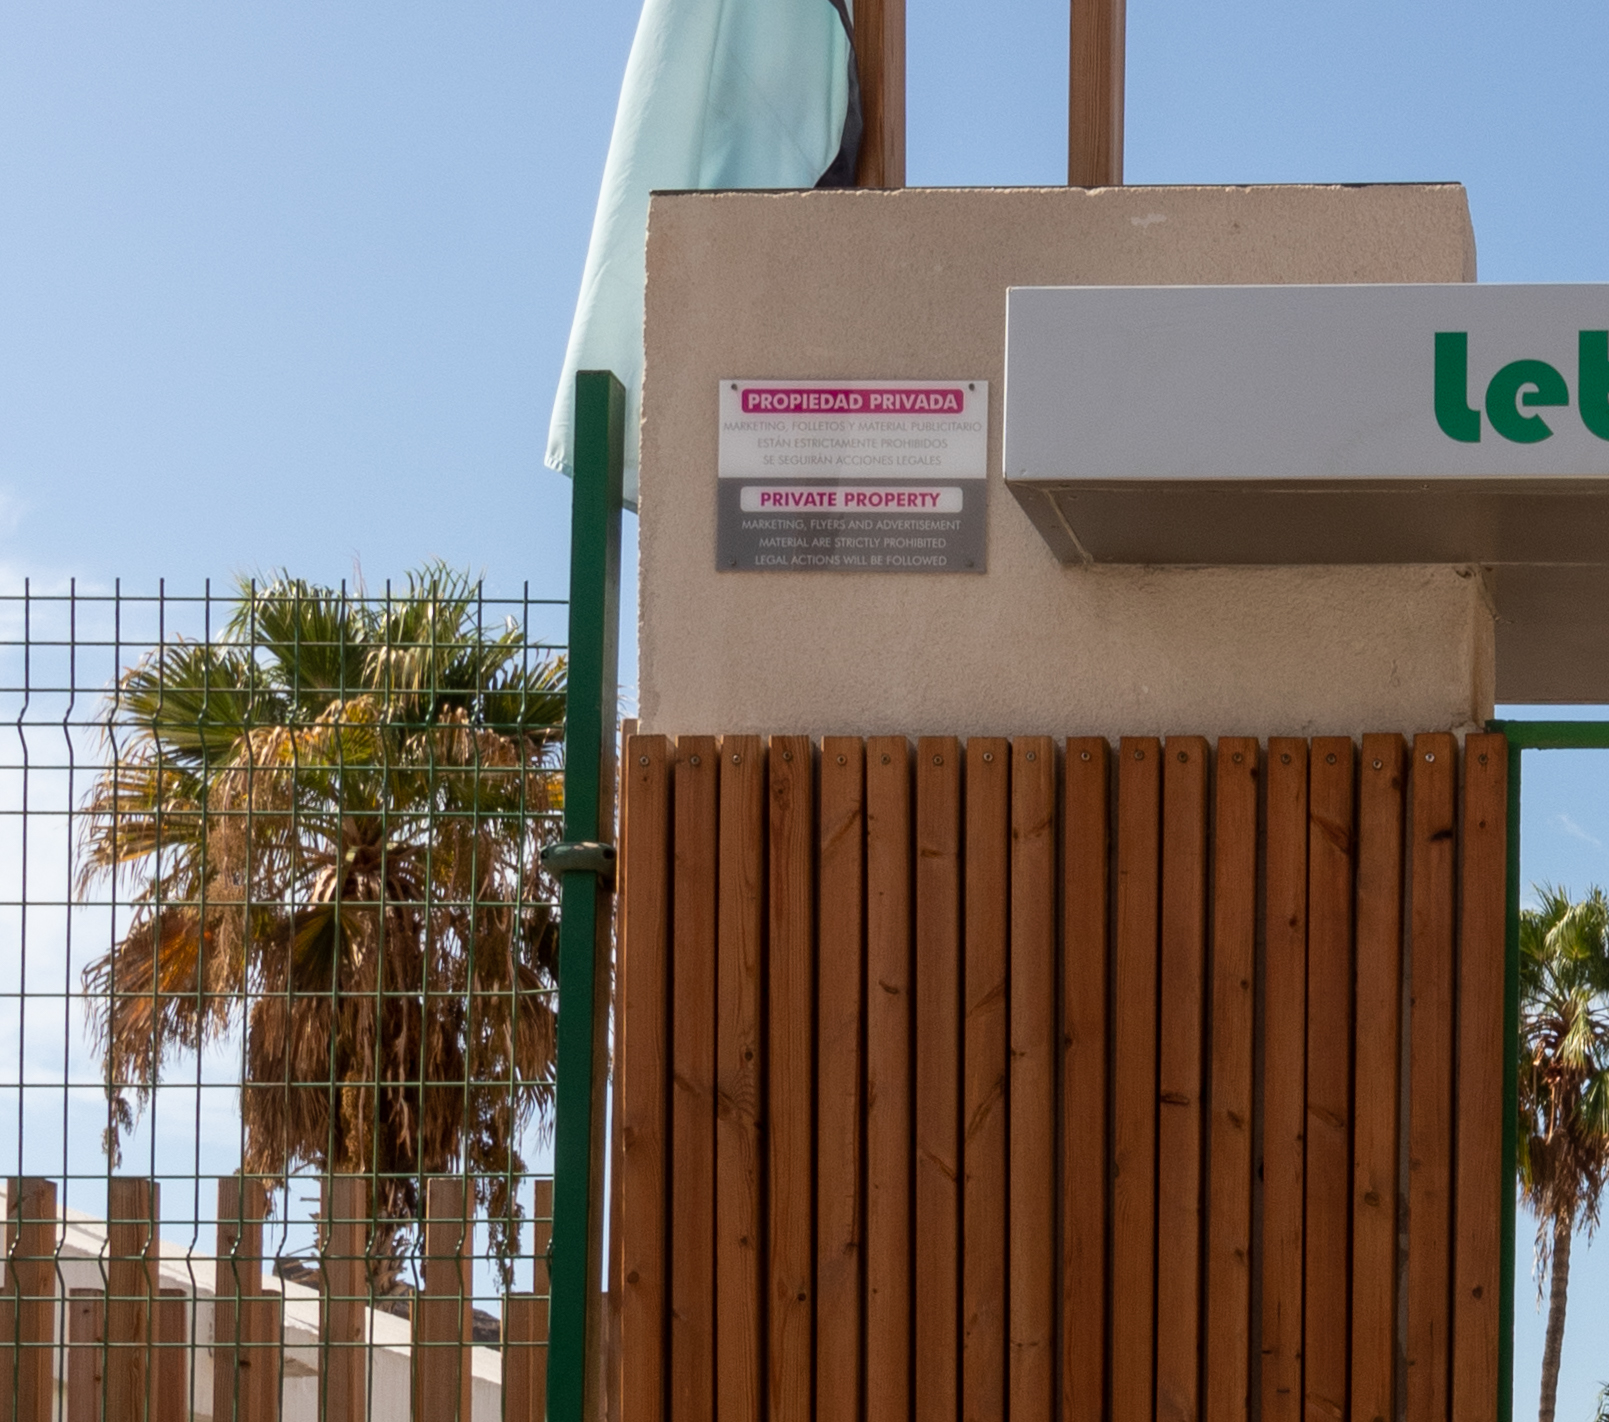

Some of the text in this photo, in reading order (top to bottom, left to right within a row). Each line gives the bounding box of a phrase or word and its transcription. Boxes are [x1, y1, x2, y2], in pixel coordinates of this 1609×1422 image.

[747, 393, 958, 410] PROPIEDAD PRIVADA
[723, 421, 982, 432] MARKETING, FOLLETOS Y MATERIAL PUBLICITARIO
[757, 435, 948, 449] ESTÁN ESTRICTAMENTE PROHIBIDOS
[763, 453, 941, 466] SE SEGUIRÁN ACCIONES LEGALES
[760, 491, 940, 507] PRIVATE PROPERTY
[741, 519, 961, 531] MARKETING, FLYERS AND ADVERTISEMENT
[760, 537, 946, 548] MATERIAL ARE STRICTLY PROHIBITED
[755, 555, 947, 566] LEGAL ACTIONS WILL BE FOLLOWED
